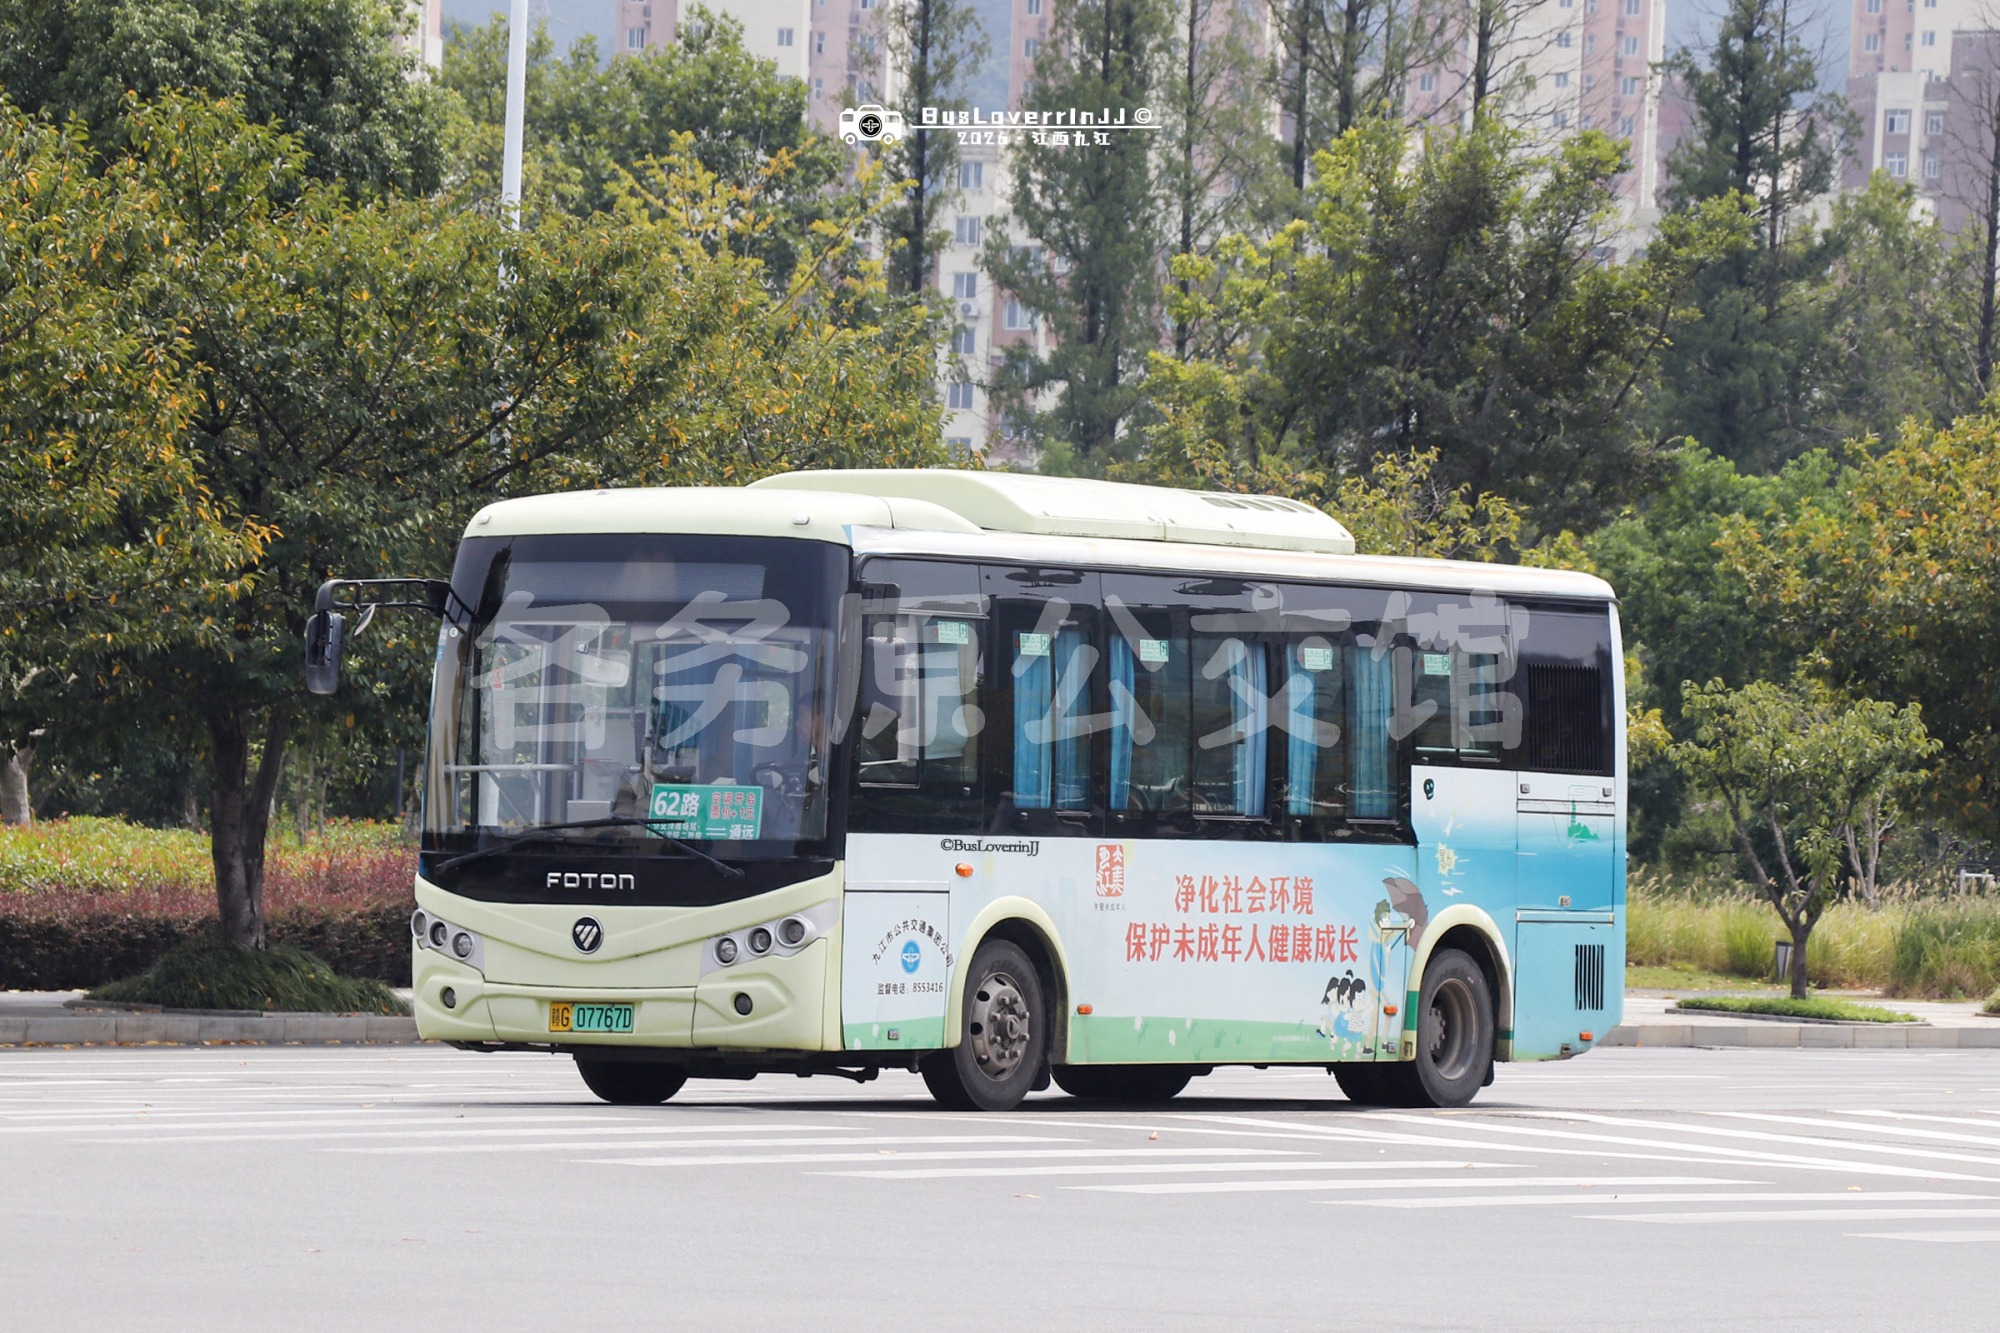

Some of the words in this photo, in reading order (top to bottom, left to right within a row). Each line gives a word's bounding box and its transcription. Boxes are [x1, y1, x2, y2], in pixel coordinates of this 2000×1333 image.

[654, 791, 700, 818] 62路
[711, 791, 756, 806] 空调开启
[546, 872, 635, 890] FOTON
[1174, 874, 1314, 915] 净化社会环境
[872, 918, 954, 968] 九江市公共交通集团公司
[1124, 921, 1359, 963] 保护未成年人健康成长
[912, 982, 944, 993] 8553416
